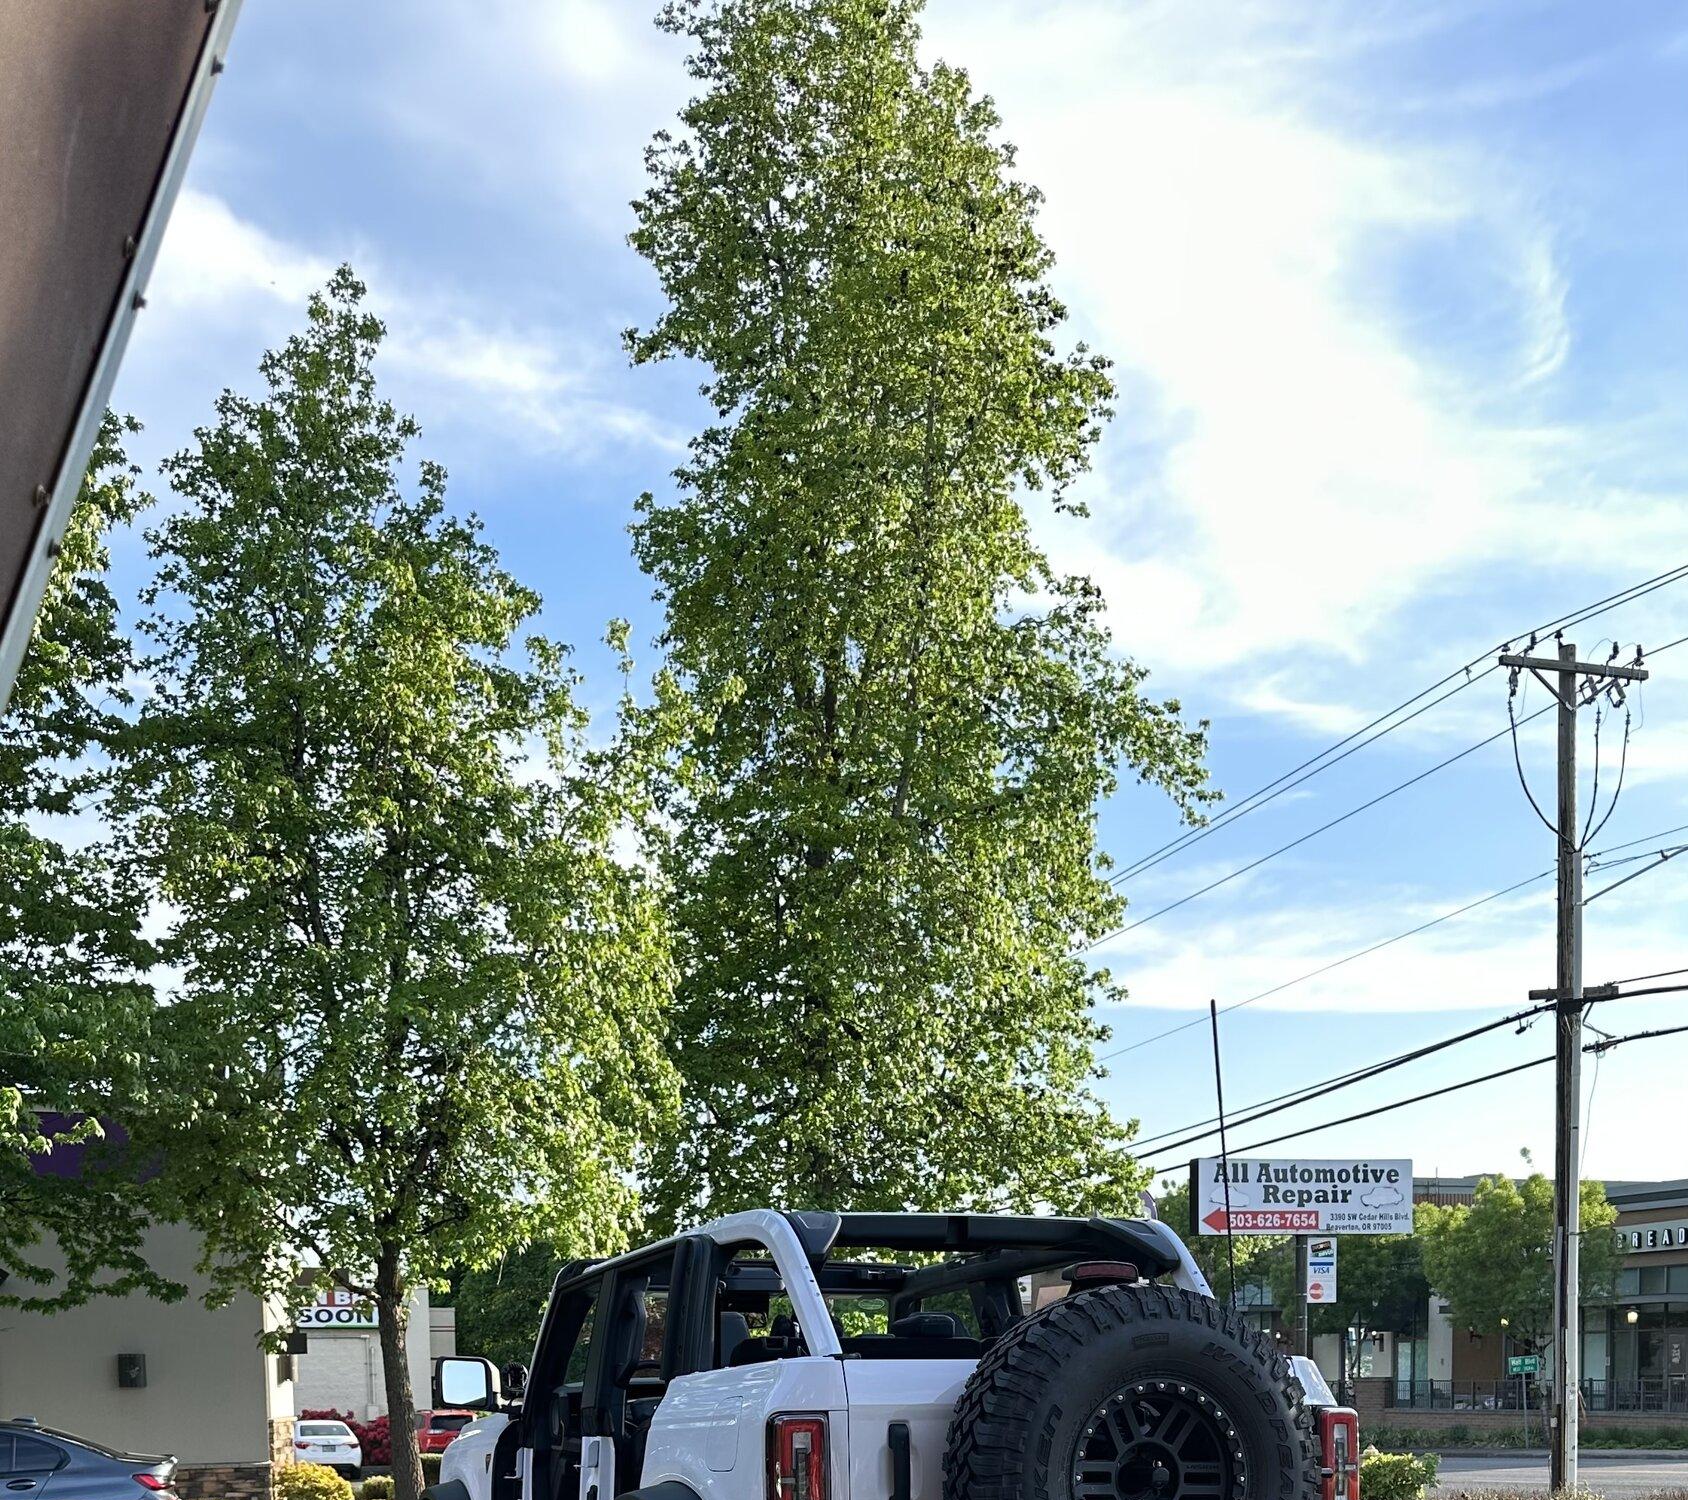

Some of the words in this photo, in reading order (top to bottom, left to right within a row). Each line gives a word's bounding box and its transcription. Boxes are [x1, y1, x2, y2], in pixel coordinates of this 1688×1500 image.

[1214, 1163, 1249, 1183] All
[1257, 1163, 1399, 1184] Automotive
[1263, 1184, 1352, 1208] Repair
[1229, 1213, 1317, 1227] 503-626-7654
[1330, 1212, 1346, 1221] 3390
[1347, 1212, 1358, 1221] SW
[1359, 1212, 1378, 1221] Cedar
[1379, 1212, 1394, 1221] Hills
[1394, 1212, 1410, 1221] Blvd.
[1326, 1223, 1361, 1232] Beaverton,
[1362, 1223, 1372, 1231] OR
[1373, 1222, 1392, 1231] 97005
[1313, 1266, 1330, 1274] VISA
[299, 1308, 374, 1324] SOON
